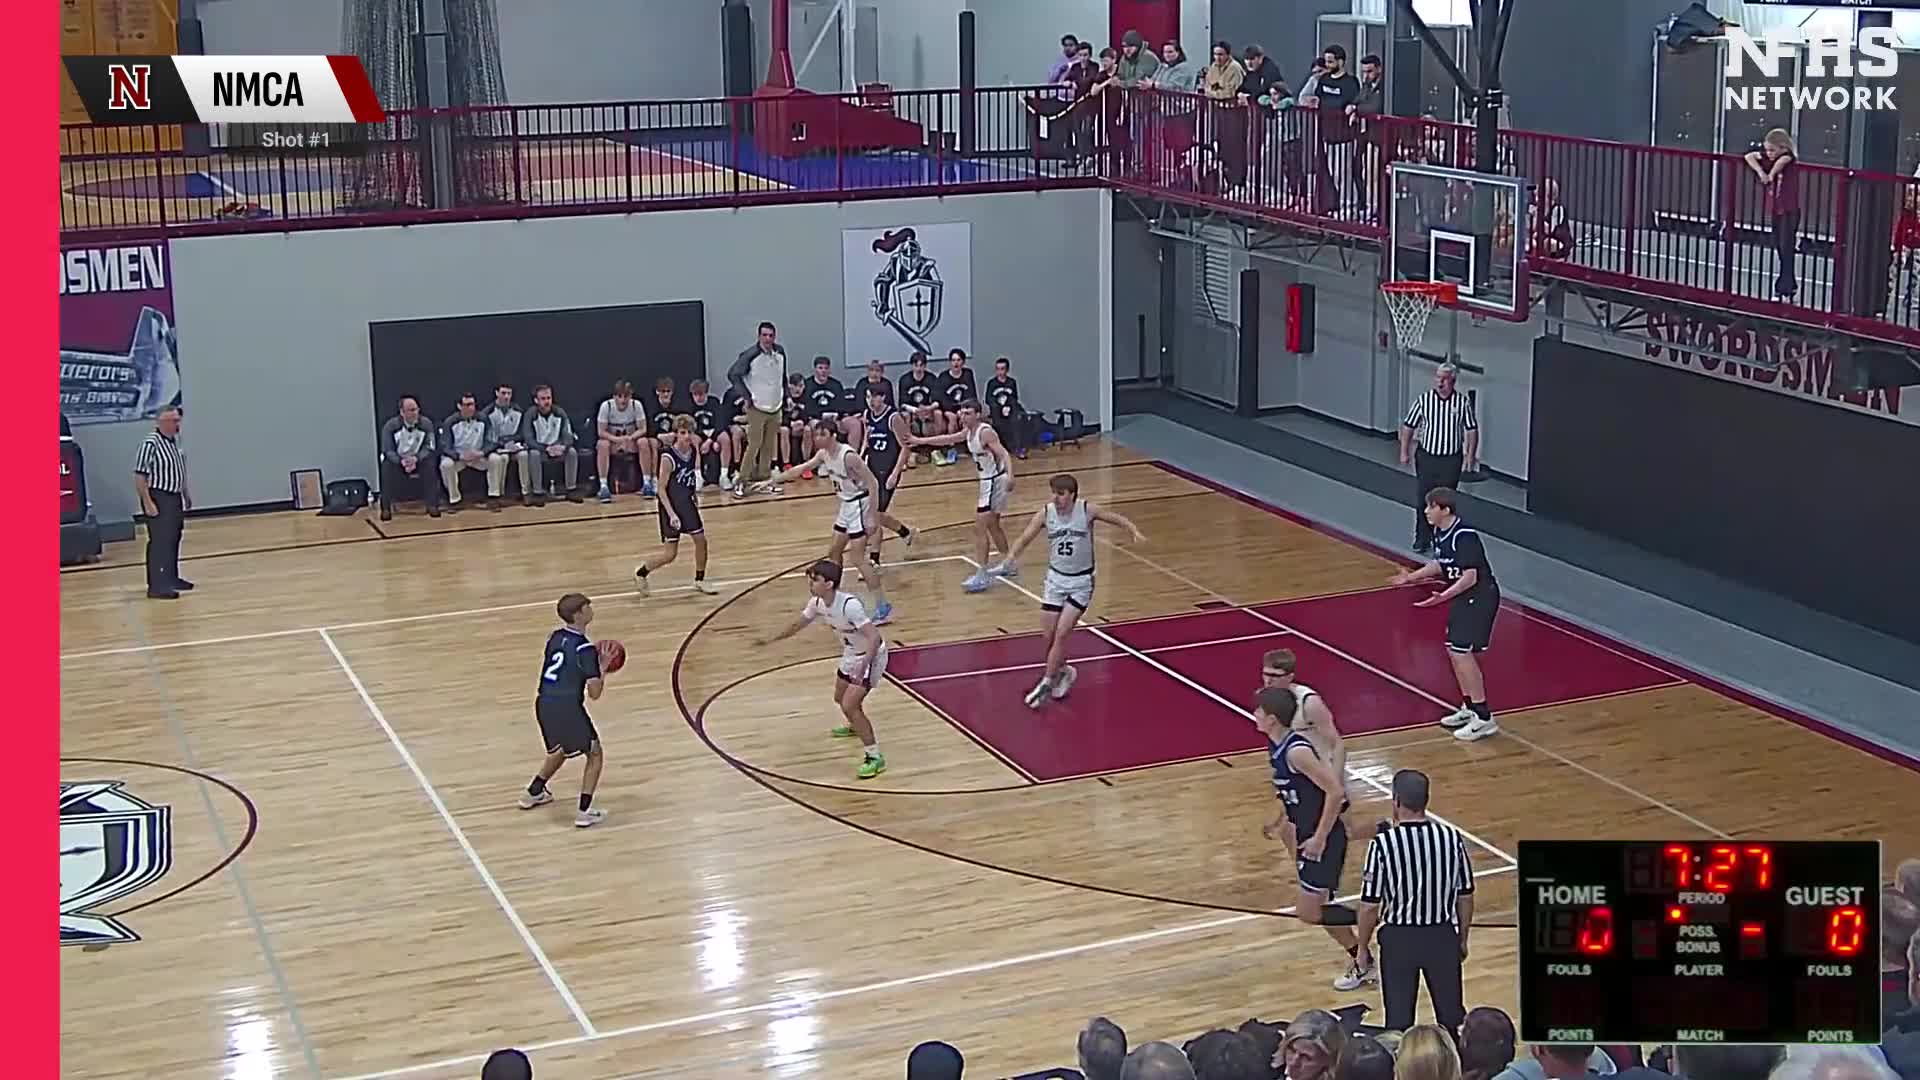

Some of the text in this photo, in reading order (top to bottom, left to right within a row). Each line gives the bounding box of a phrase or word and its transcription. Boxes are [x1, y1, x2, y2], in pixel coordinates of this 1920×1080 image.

[1645, 311, 1900, 415] SWORDSMN
[1058, 541, 1073, 556] 25
[1447, 566, 1461, 579] 22
[544, 651, 564, 681] 2
